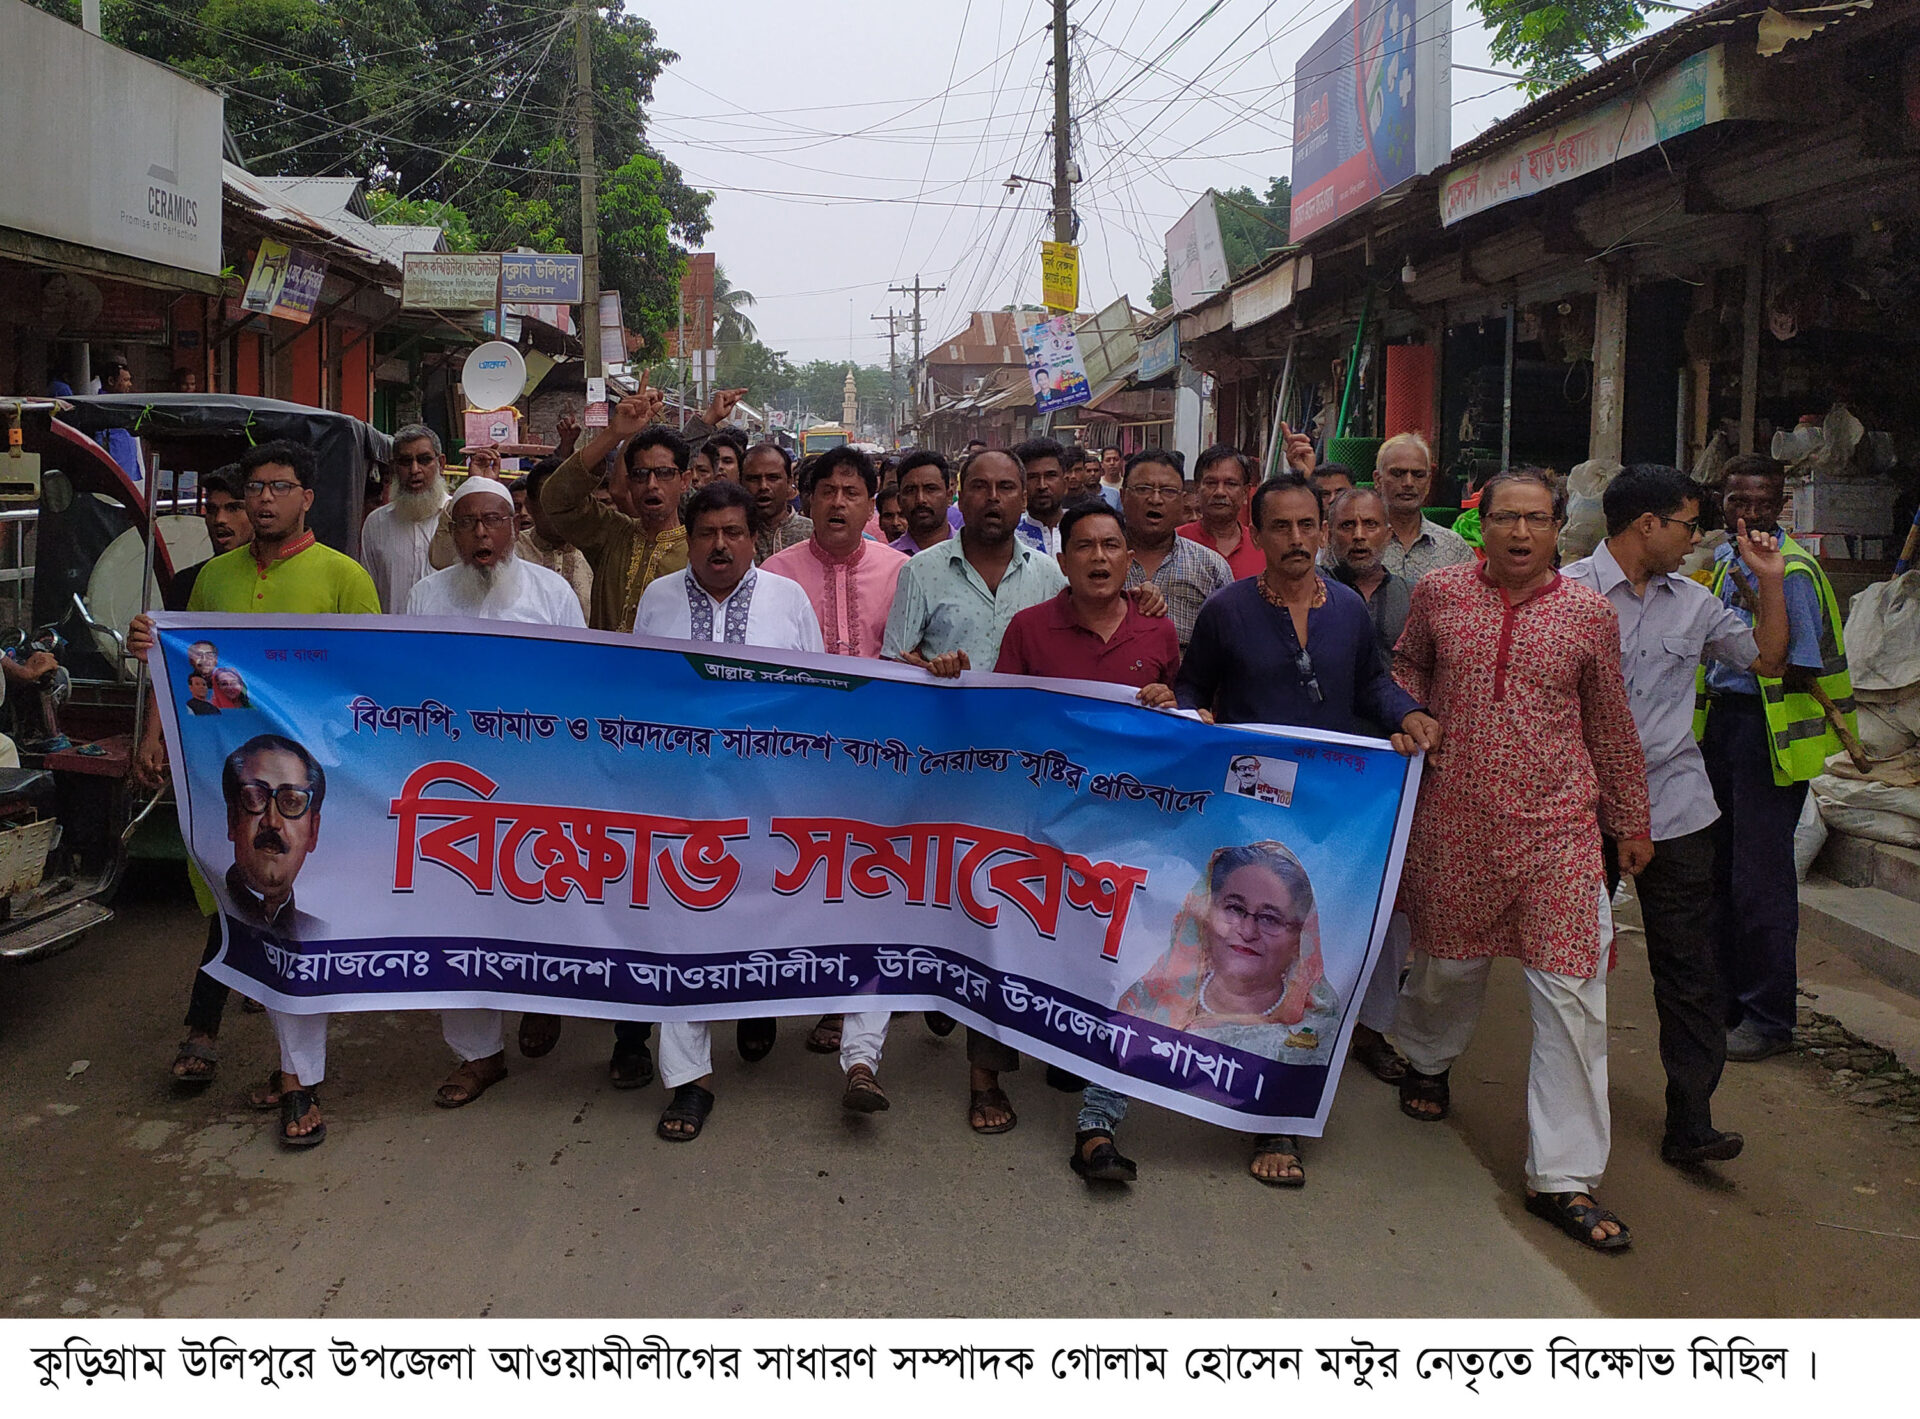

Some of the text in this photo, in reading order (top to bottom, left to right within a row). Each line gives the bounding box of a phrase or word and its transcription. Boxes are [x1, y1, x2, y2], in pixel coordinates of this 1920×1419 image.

[148, 186, 198, 228] CERAMICS
[120, 210, 198, 242] Promise of Perfection
[502, 258, 577, 285] সক্লাব উলিপুর
[504, 283, 556, 297] কুড়িগ্রাম
[264, 648, 328, 663] জয় বাংলা
[347, 695, 1215, 816] বিএনপি, জামাত ও ছাত্রদলের সারাদেশ ব্যাপী নৈরাজ্য সৃষ্টির প্রতিবাদে
[390, 759, 1150, 964] বিক্ষোভ সমাবেশ
[262, 940, 430, 982] আয়োজনেঃ
[442, 946, 619, 989] বাংলাদেশ
[627, 948, 860, 993] আওয়ামীলীগ,
[872, 946, 992, 1002] উলিপুর
[999, 974, 1140, 1059] উপজেলা
[1147, 1034, 1245, 1093] শাখা
